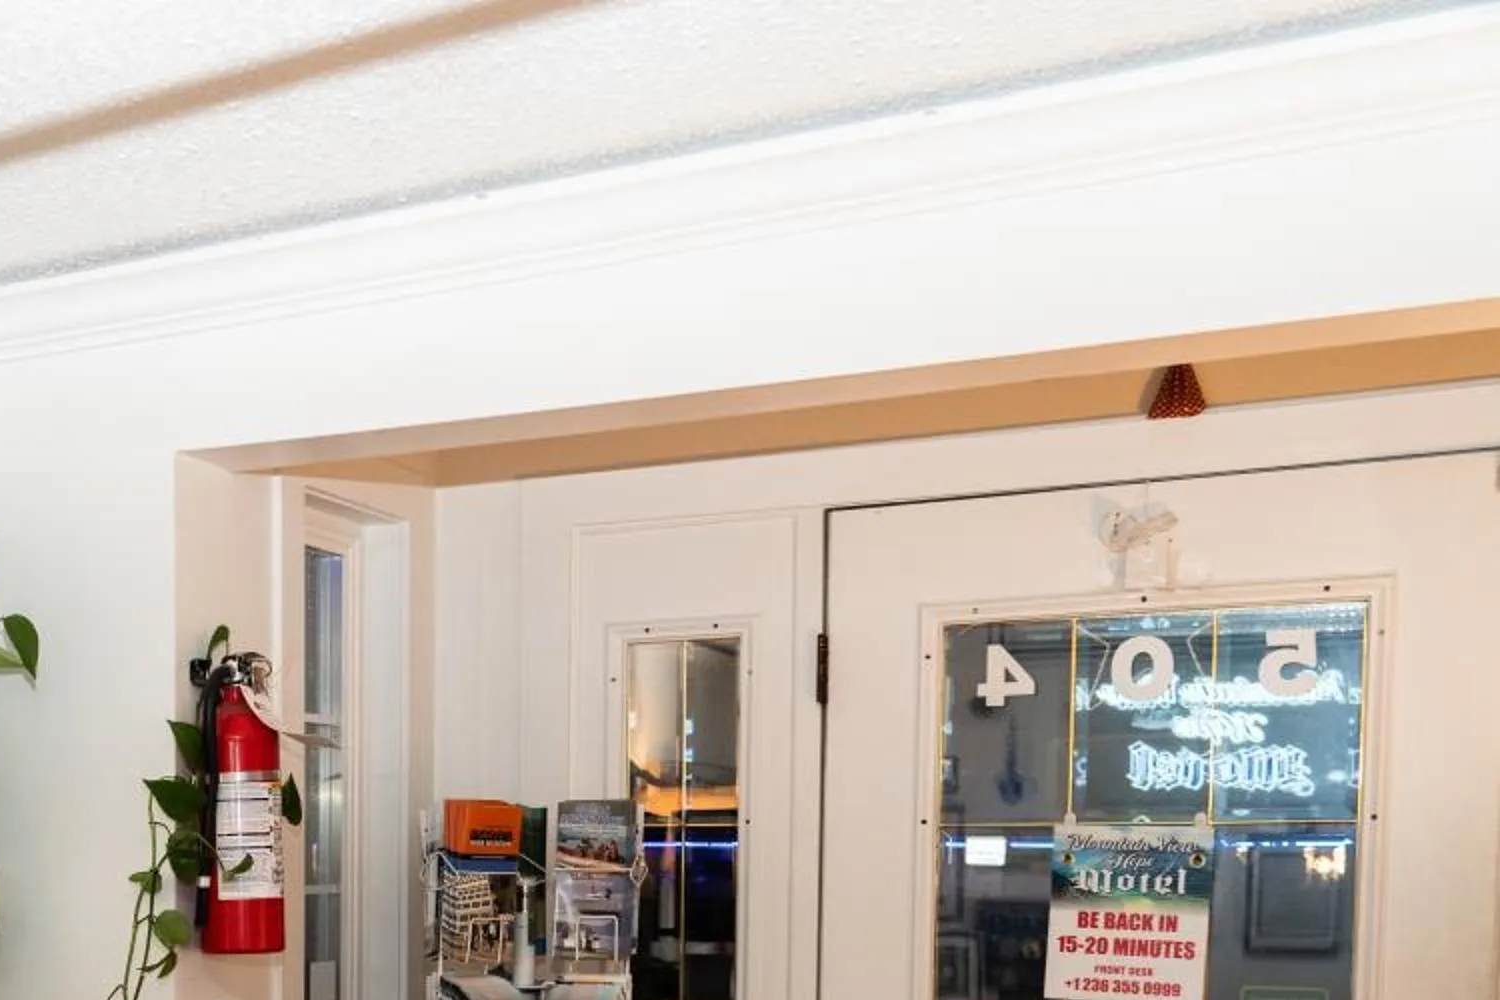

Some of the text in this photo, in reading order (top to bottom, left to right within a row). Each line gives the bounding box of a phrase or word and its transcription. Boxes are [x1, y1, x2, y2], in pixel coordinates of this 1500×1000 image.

[1067, 833, 1149, 851] Mountain
[1107, 852, 1153, 869] Hope
[1070, 864, 1188, 896] Motel
[1077, 911, 1179, 933] BE BACK IN
[1057, 935, 1196, 961] 15-20 MINUTES
[1094, 965, 1154, 977] FRONT DESK
[1112, 979, 1140, 995] 355
